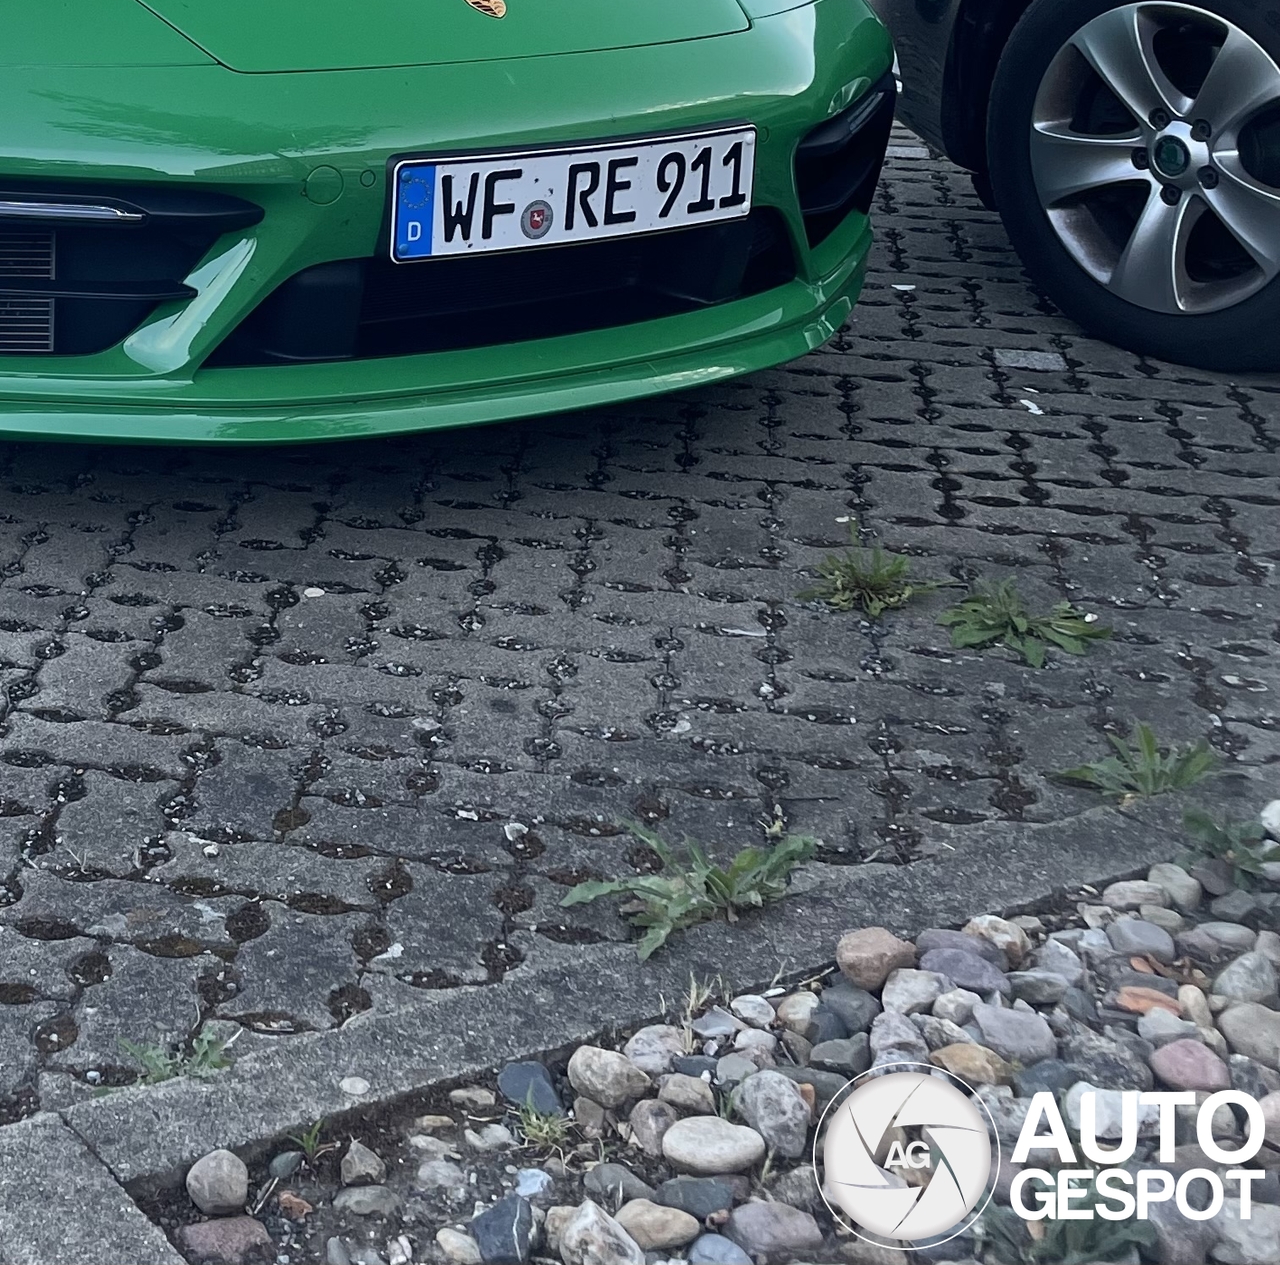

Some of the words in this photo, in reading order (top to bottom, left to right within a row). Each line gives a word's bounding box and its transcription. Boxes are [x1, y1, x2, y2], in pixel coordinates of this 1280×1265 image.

[441, 168, 523, 243] WF
[564, 156, 639, 231] RE
[656, 141, 746, 219] 911
[407, 221, 421, 242] D
